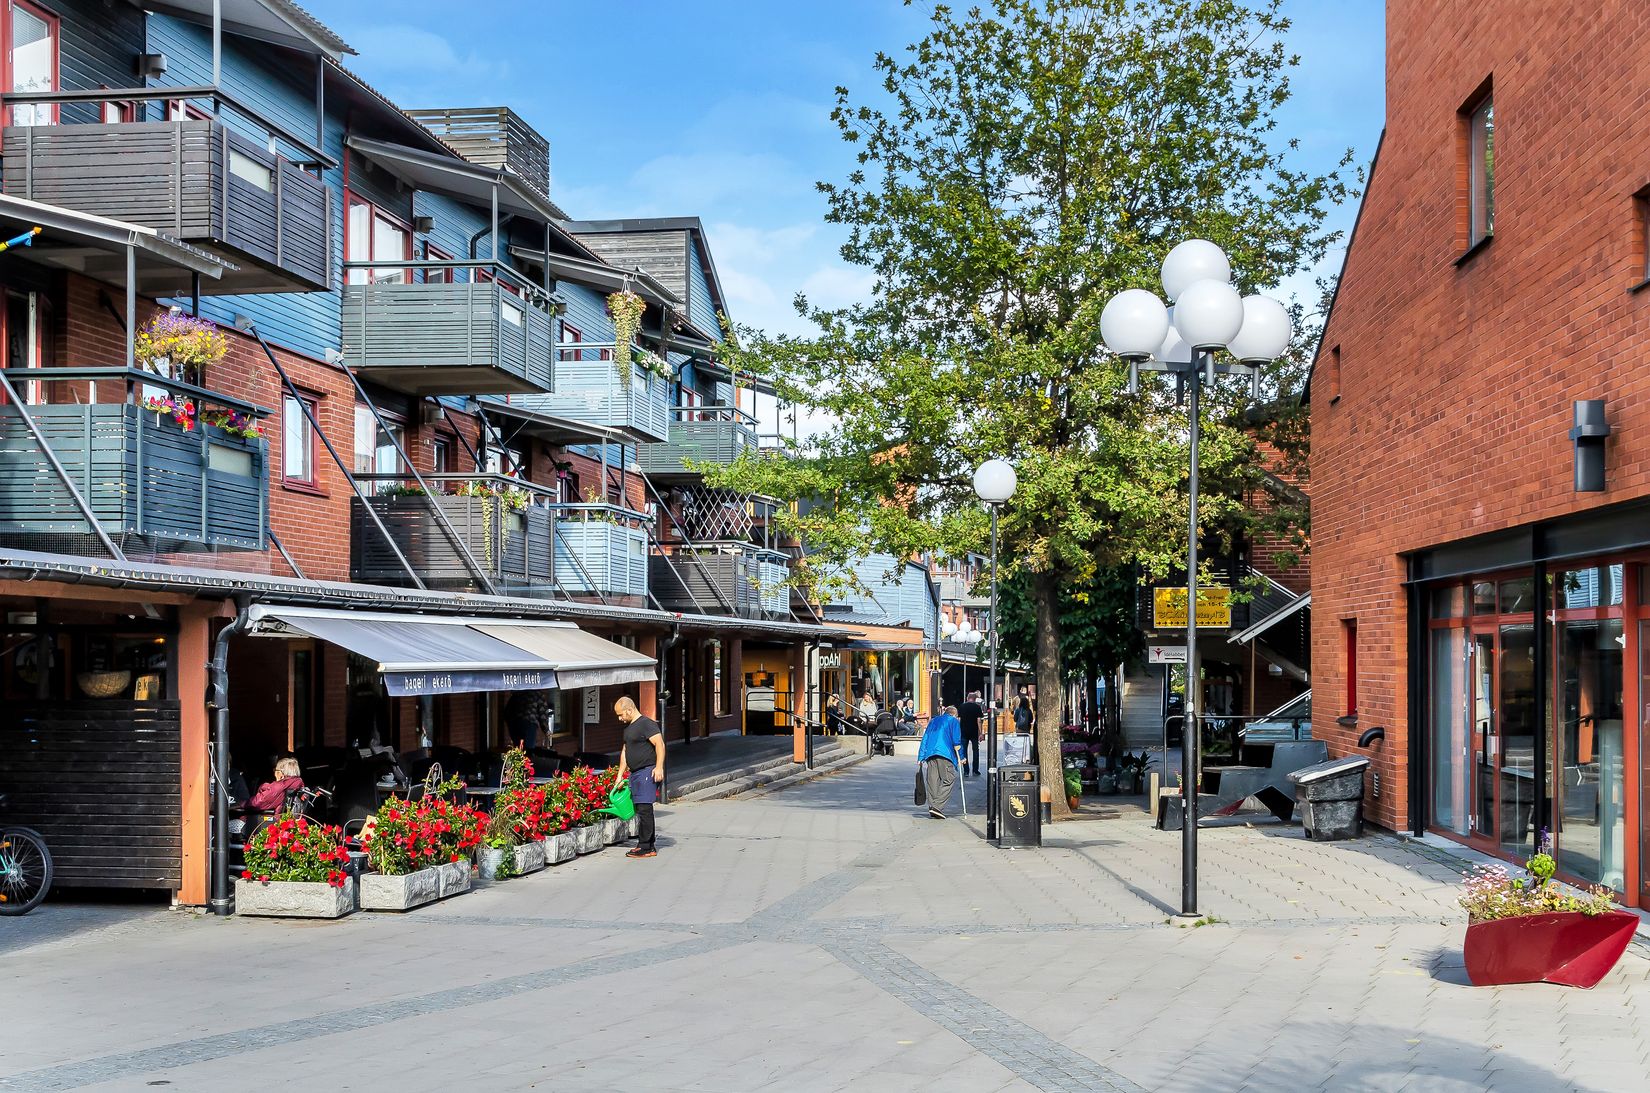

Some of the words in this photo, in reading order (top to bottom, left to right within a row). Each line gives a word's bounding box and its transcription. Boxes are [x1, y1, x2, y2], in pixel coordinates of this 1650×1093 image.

[404, 675, 426, 692] bageri
[432, 674, 452, 689] ekerö
[502, 672, 522, 688] bageri
[524, 672, 541, 685] ekerö
